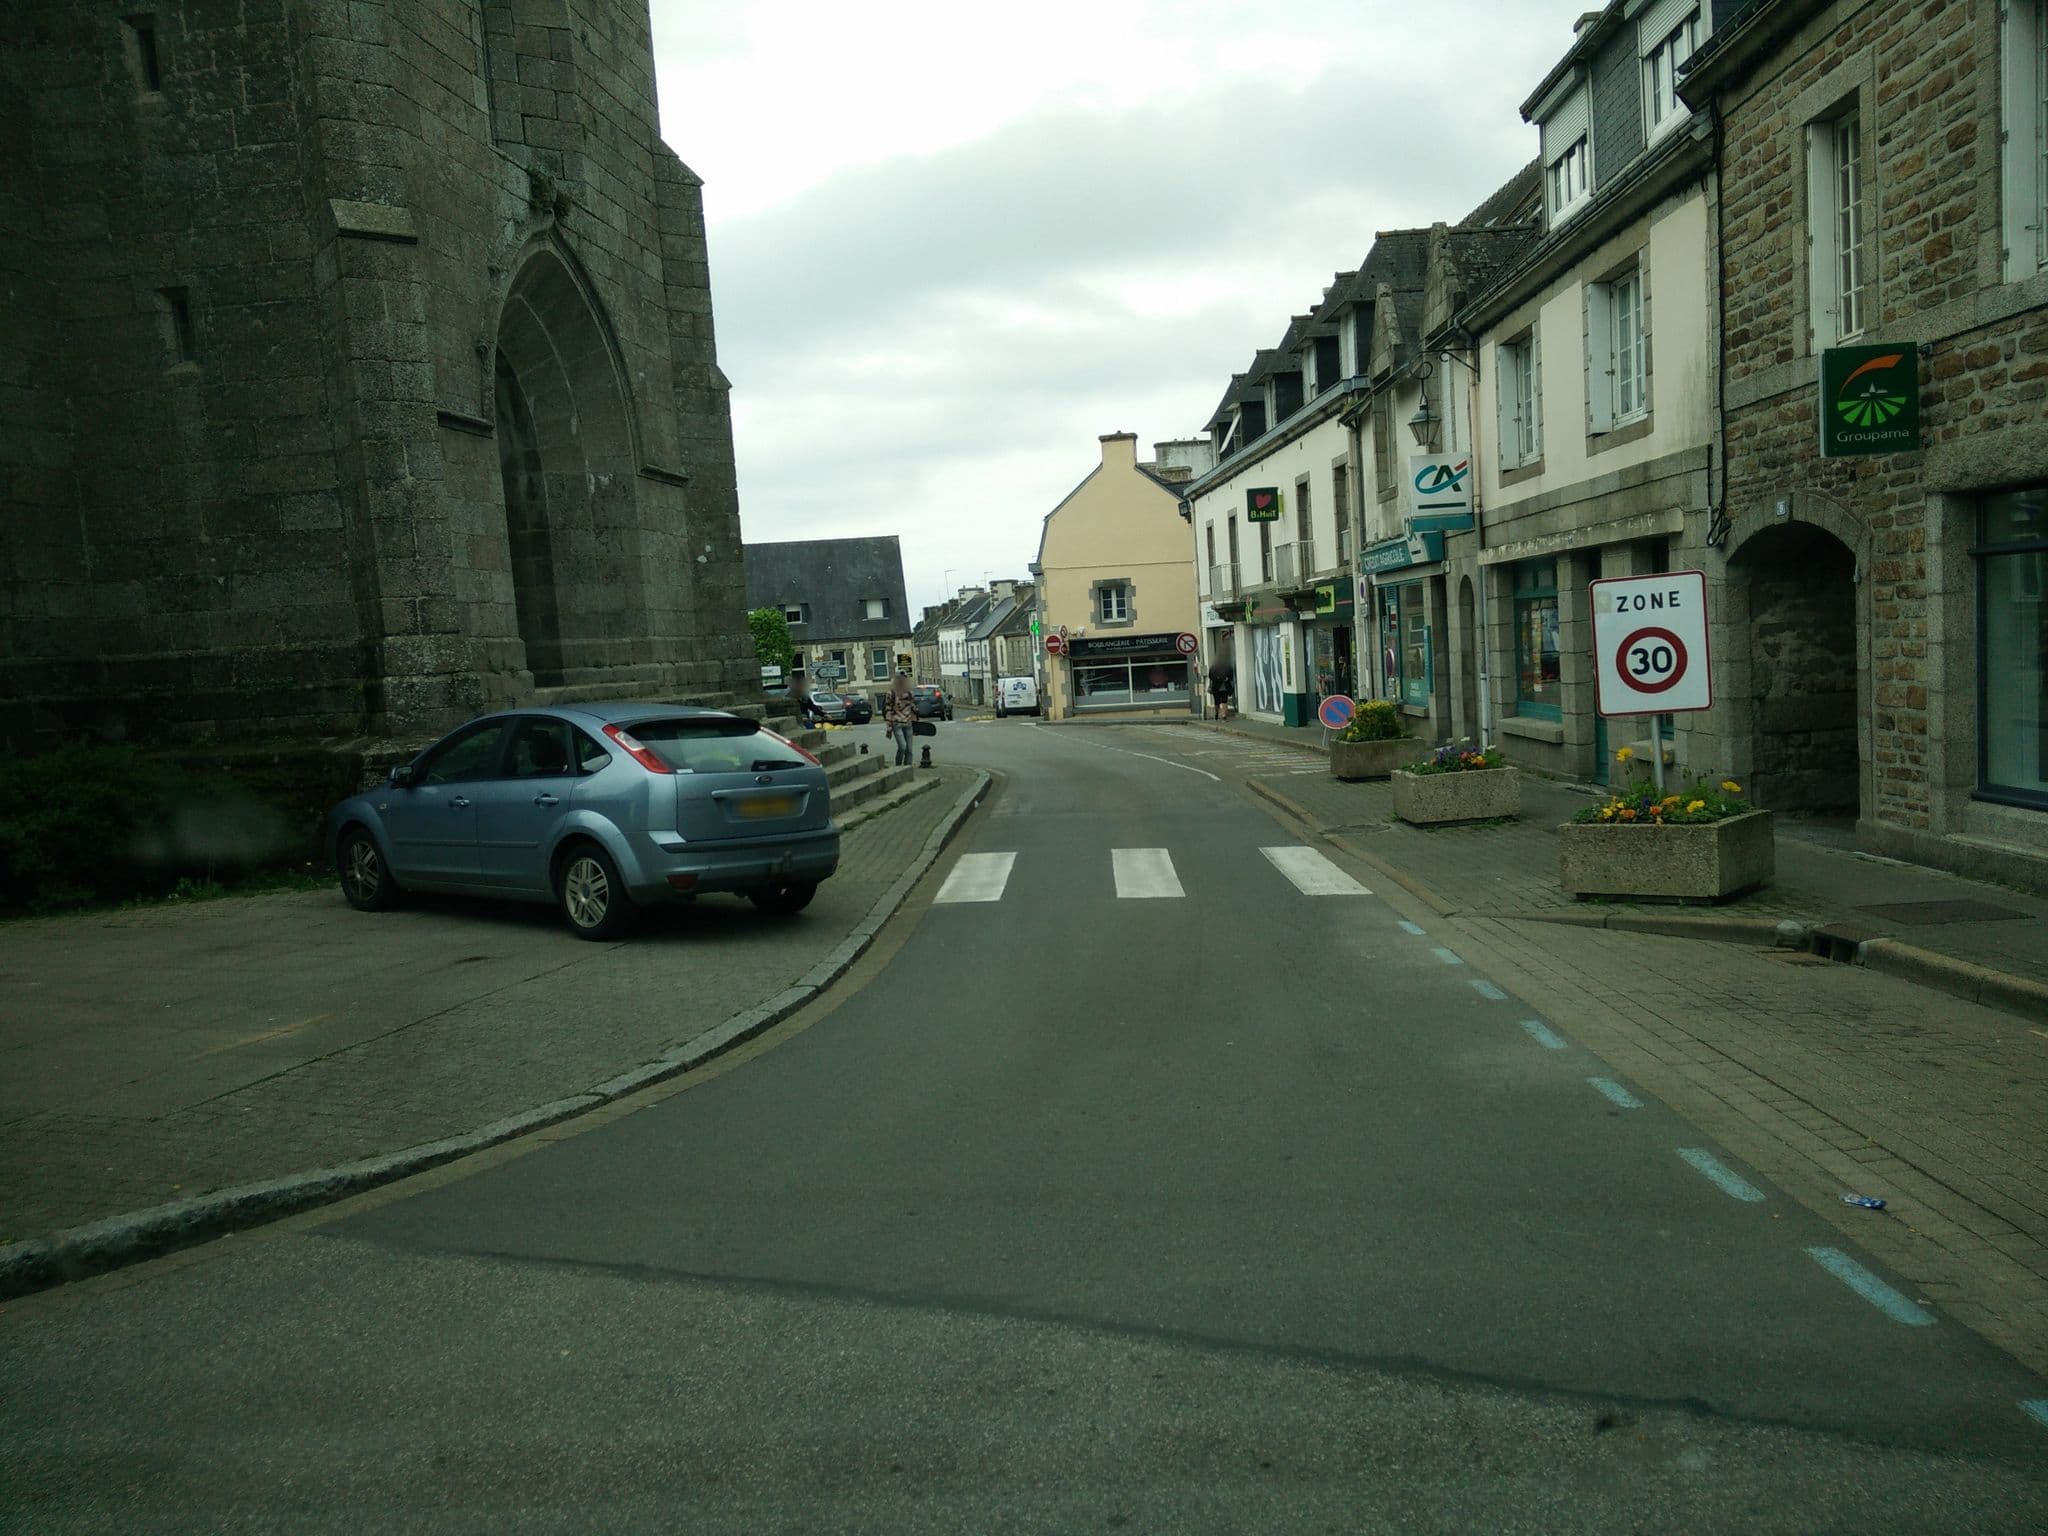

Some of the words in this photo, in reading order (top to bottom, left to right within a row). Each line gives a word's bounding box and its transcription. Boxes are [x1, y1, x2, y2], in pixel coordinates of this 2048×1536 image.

[1836, 429, 1910, 443] Groupama
[1616, 590, 1681, 613] ZONE
[1087, 639, 1130, 649] BOULANGERIE
[1631, 646, 1673, 676] 30
